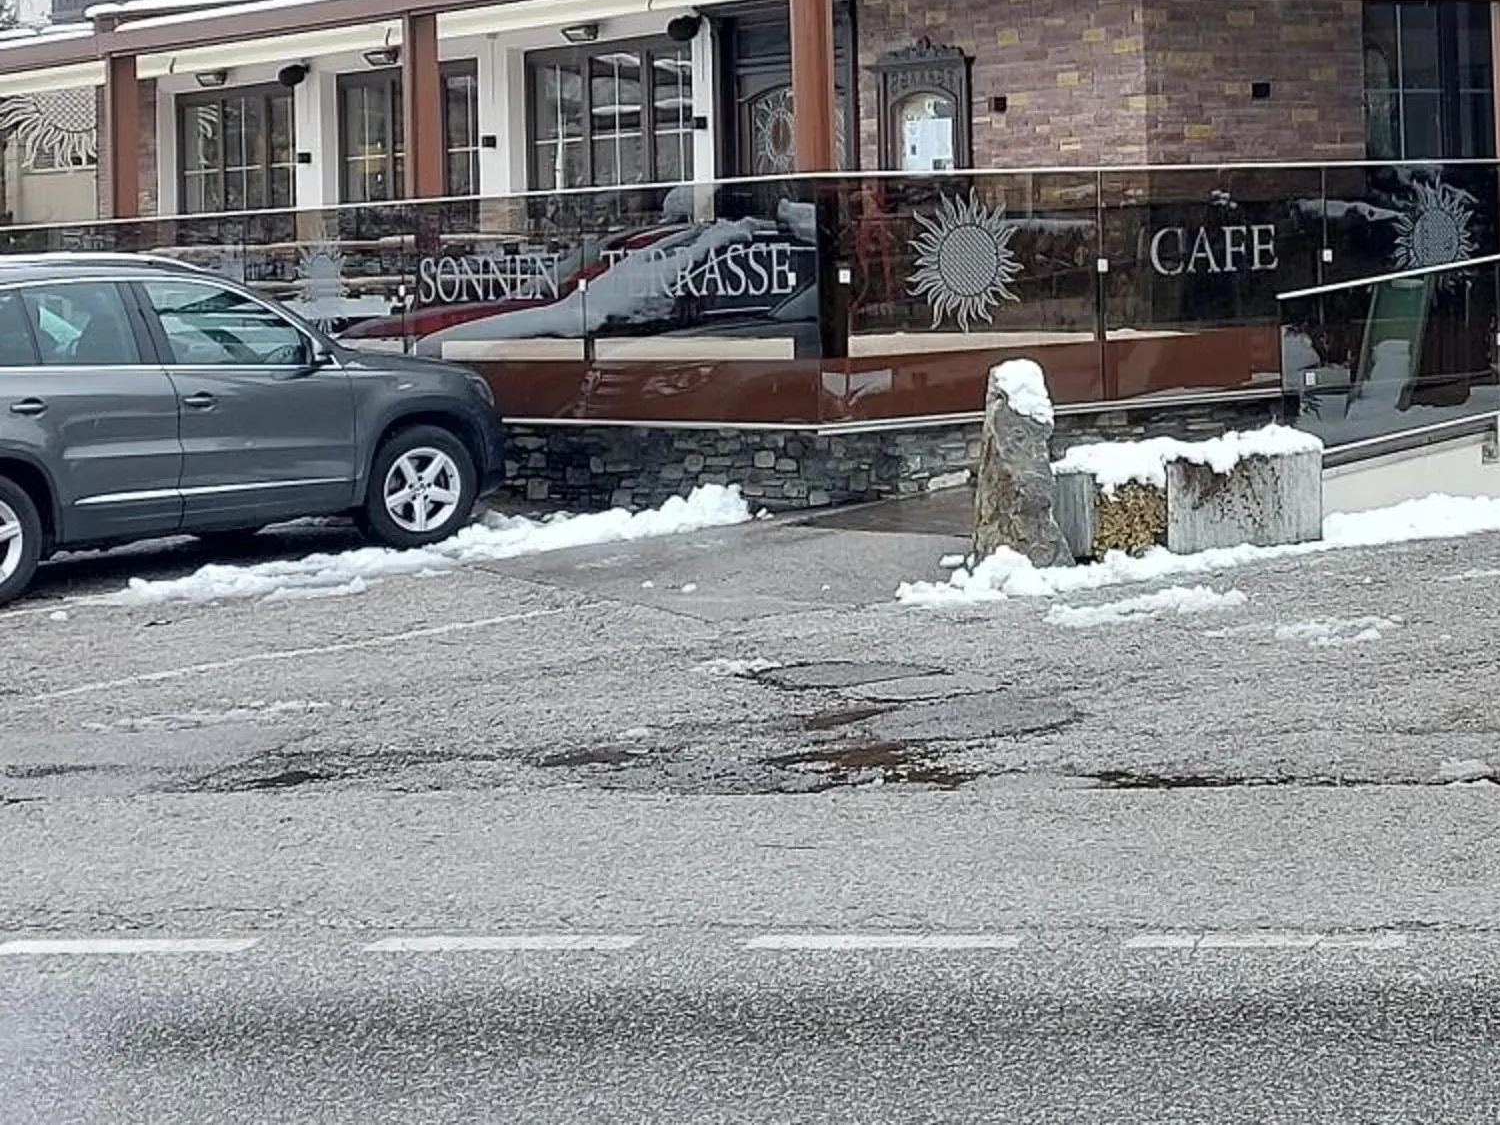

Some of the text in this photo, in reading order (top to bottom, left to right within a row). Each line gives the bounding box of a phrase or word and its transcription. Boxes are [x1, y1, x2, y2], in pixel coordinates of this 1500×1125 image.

[418, 242, 793, 303] SONNEN TERRASSE
[1150, 224, 1279, 276] CAFE
